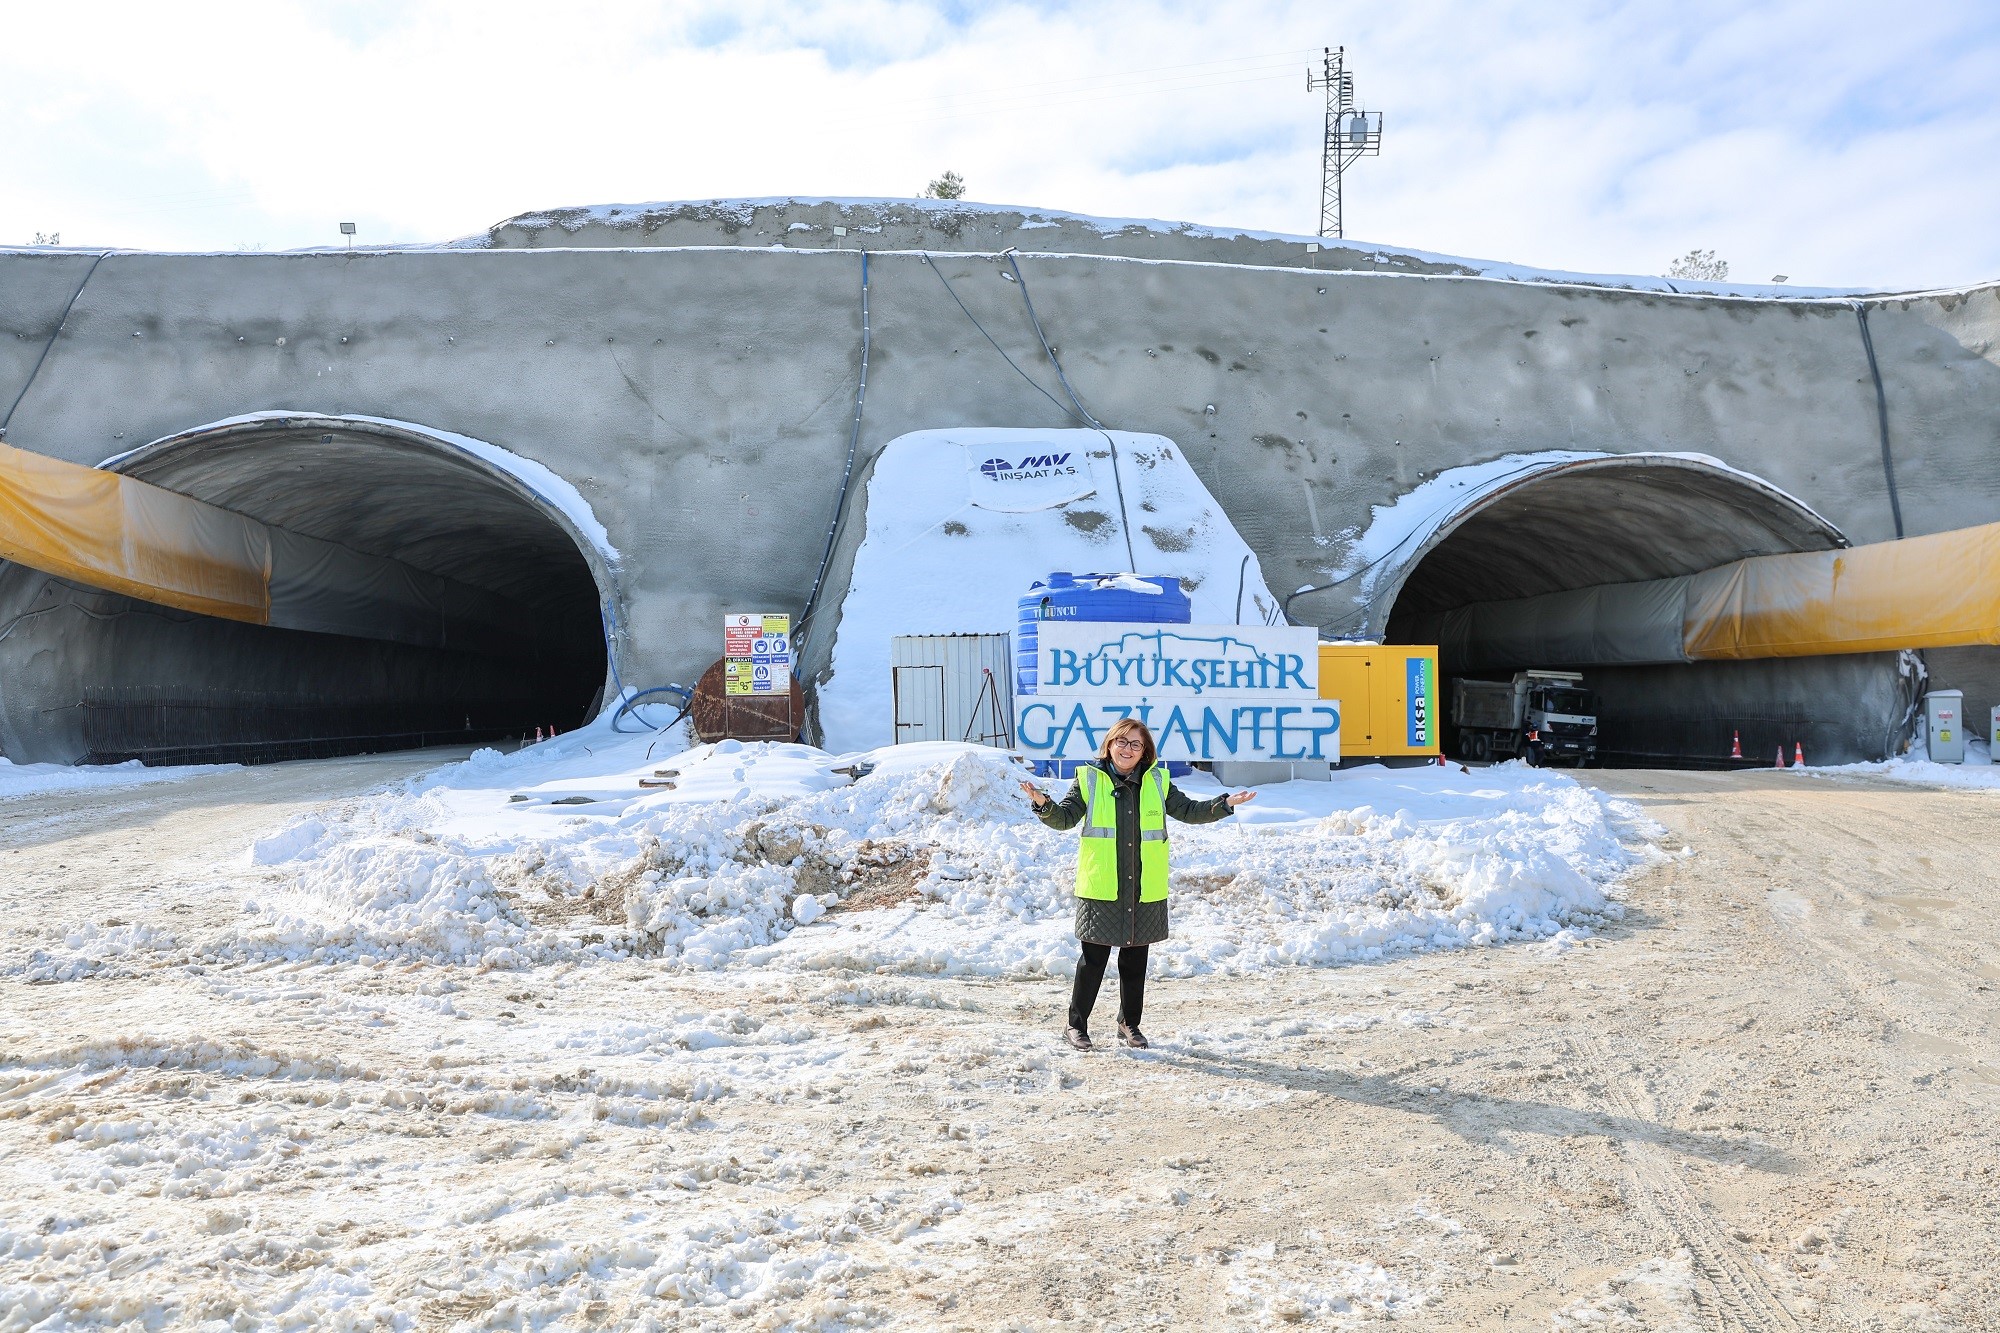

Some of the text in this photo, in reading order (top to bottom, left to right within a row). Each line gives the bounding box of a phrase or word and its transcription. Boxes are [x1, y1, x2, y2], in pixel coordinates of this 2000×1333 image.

[1000, 469, 1049, 481] İNŞAAT
[1043, 649, 1316, 694] BÜYÜKŞEHİR
[1415, 697, 1425, 741] aksa
